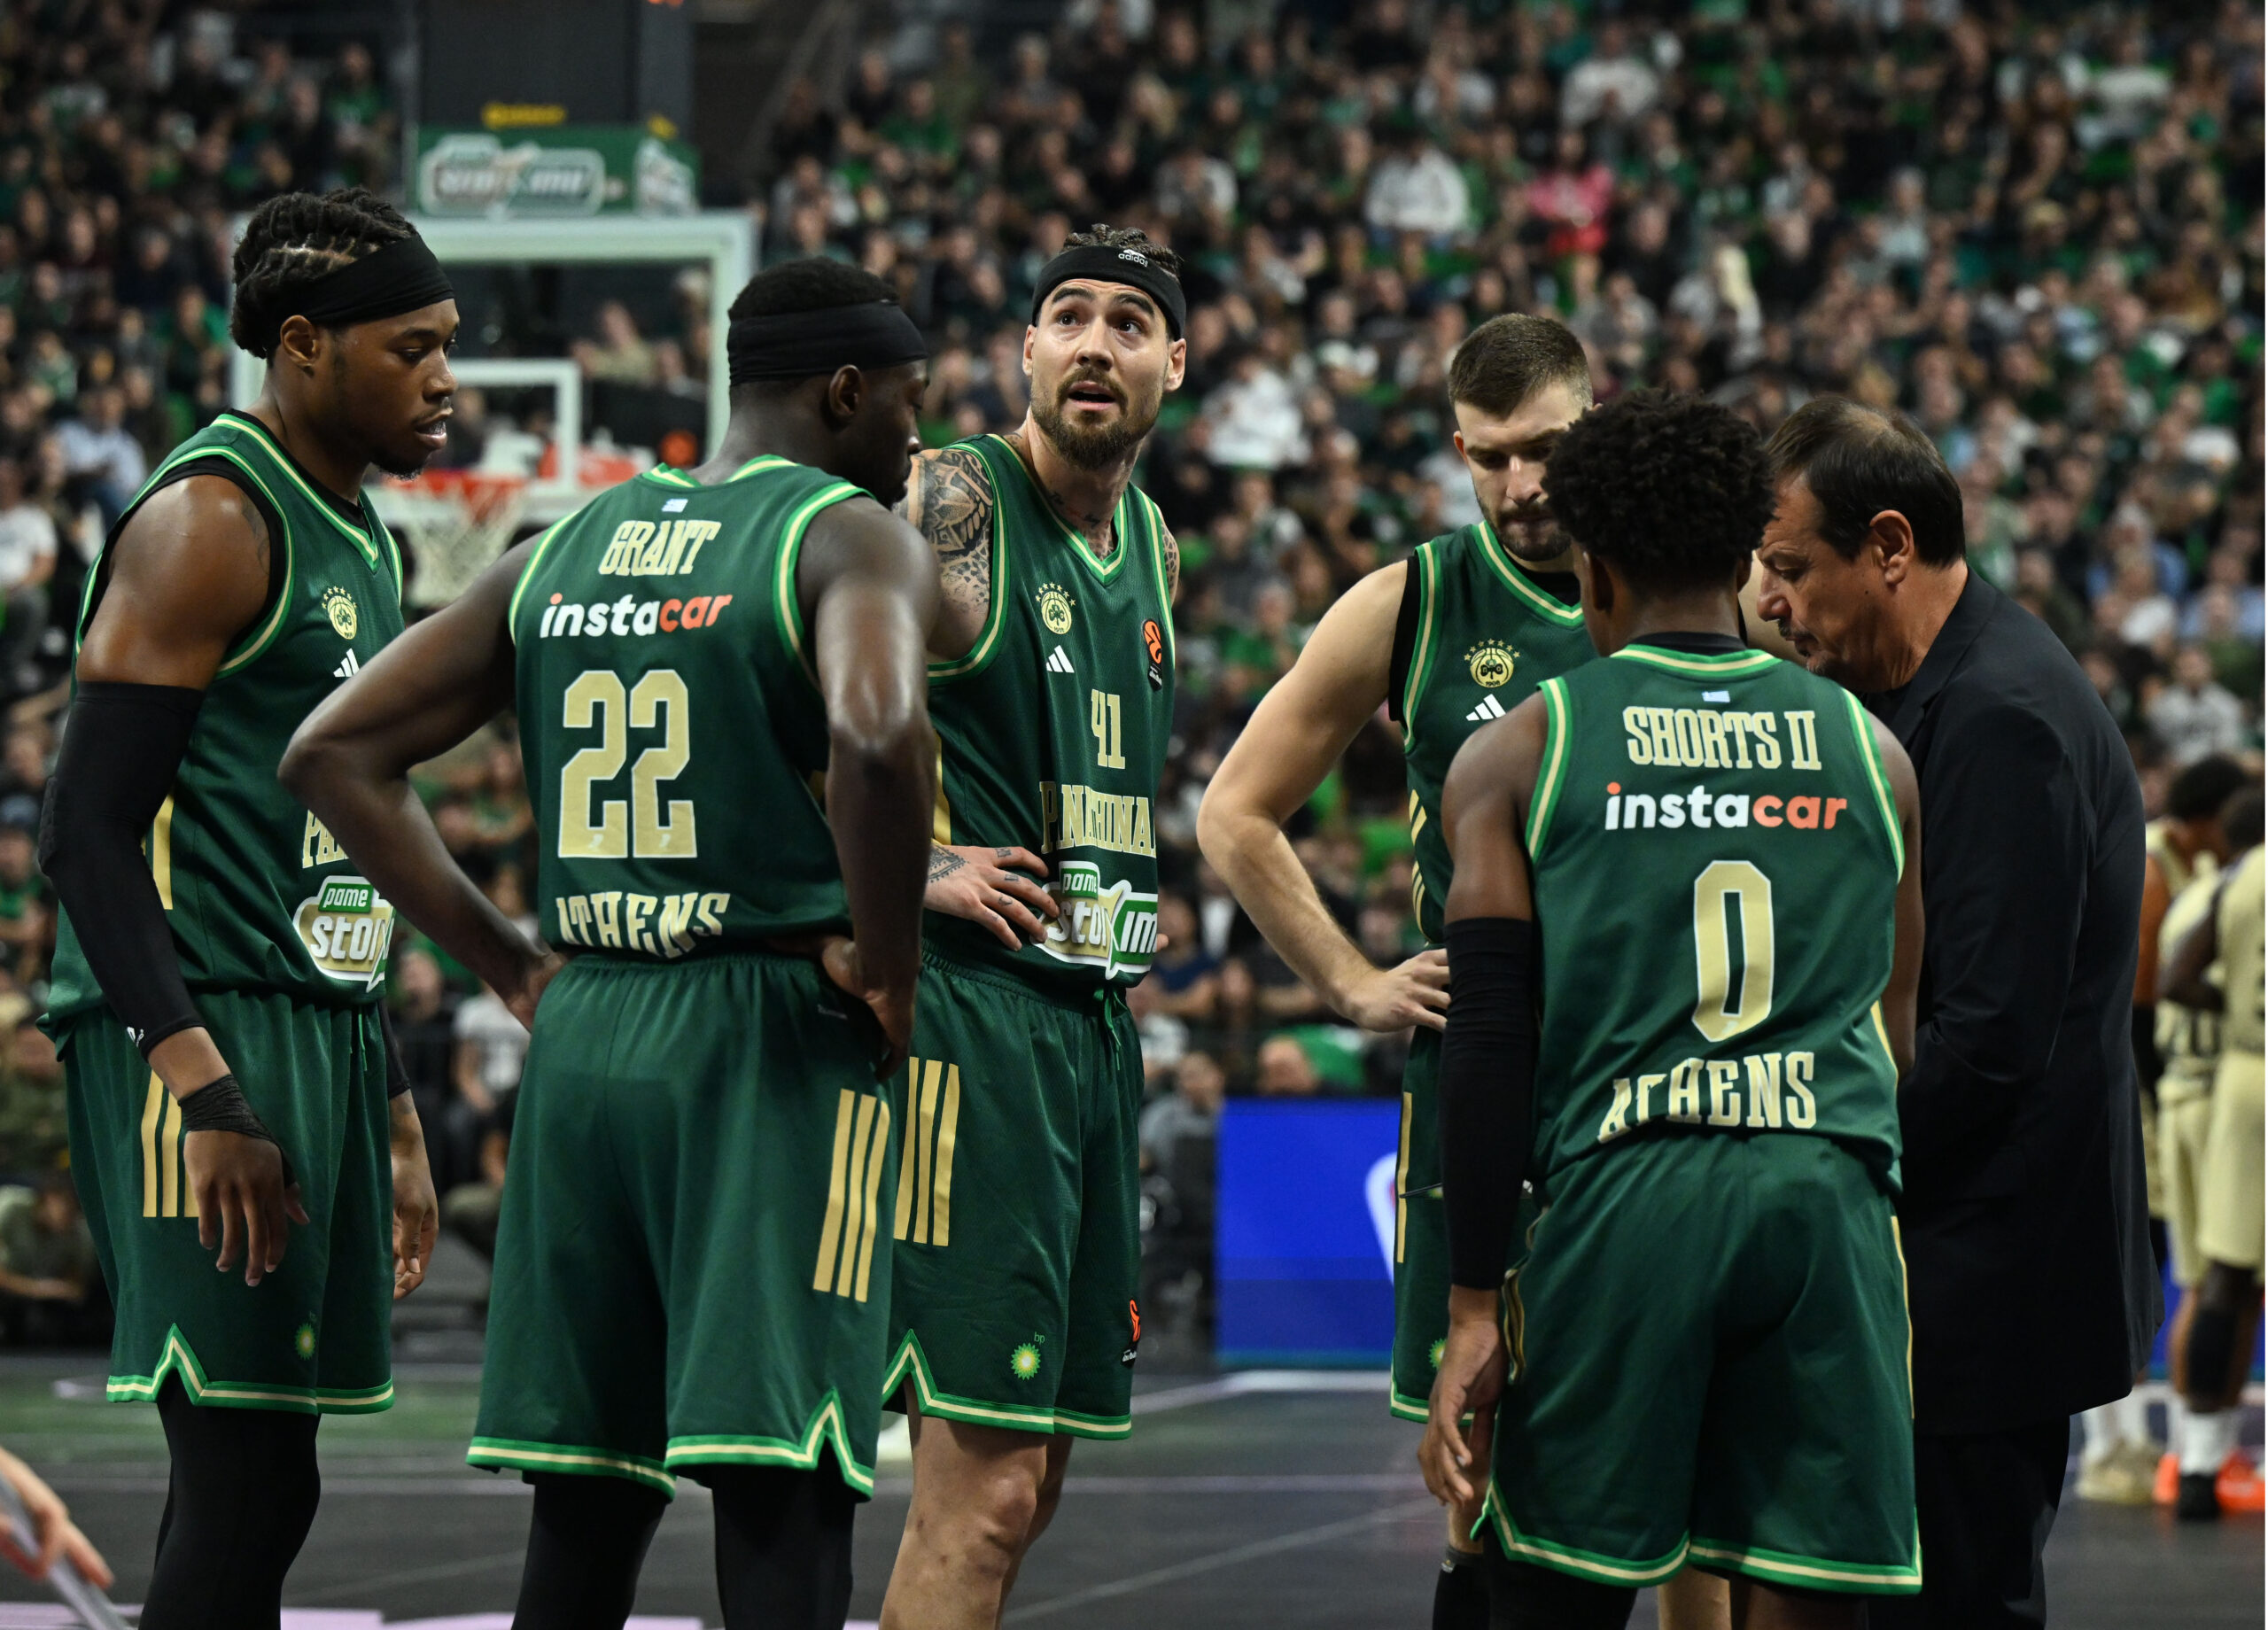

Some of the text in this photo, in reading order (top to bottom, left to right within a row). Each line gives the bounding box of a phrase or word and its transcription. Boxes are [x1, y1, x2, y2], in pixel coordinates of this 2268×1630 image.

[1118, 252, 1148, 268] adidas
[598, 520, 721, 576] GRANT
[540, 593, 733, 638] instacar
[1091, 688, 1125, 769] 41
[1623, 706, 1821, 771] SHORTS II
[558, 669, 697, 858] 22
[1604, 781, 1847, 830] instacar
[323, 888, 369, 908] pame
[1691, 860, 1775, 1043] 0
[1596, 1051, 1817, 1144] ATHENS
[1034, 1331, 1045, 1345] bp
